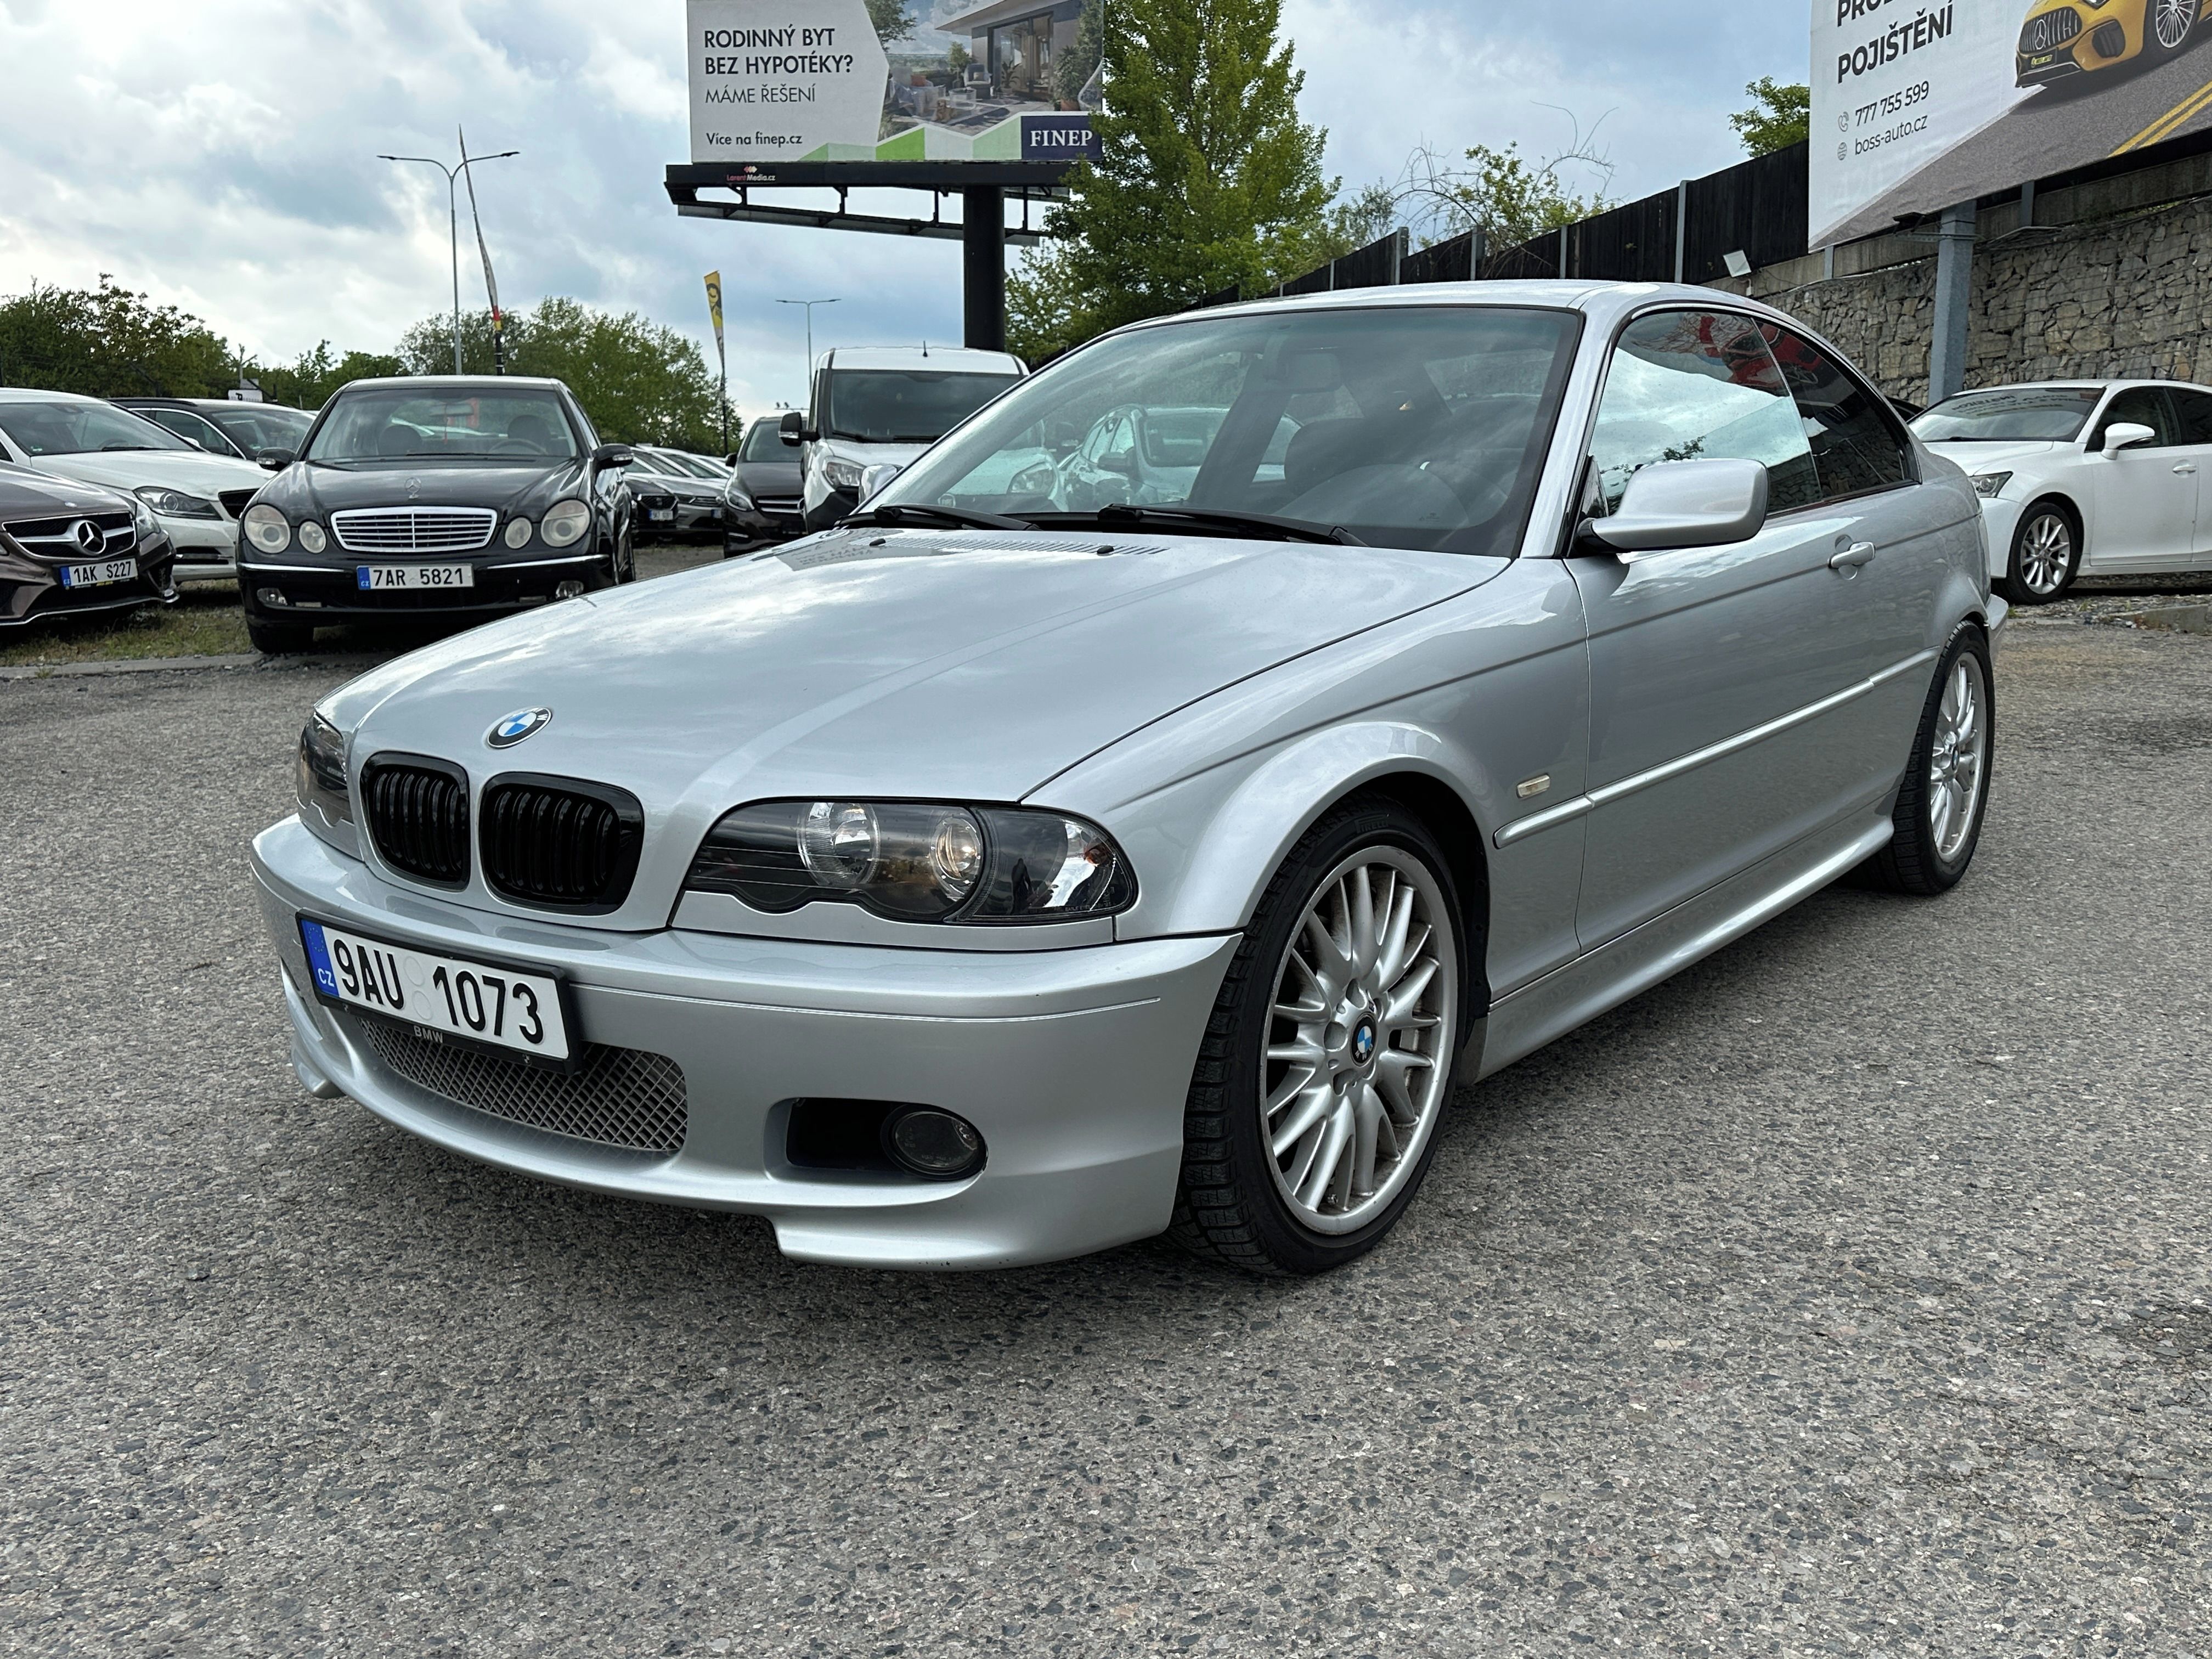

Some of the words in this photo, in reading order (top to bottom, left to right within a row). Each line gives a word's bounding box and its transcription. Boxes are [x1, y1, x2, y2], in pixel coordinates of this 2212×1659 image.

[704, 24, 796, 48] RODINNÝ
[803, 28, 835, 46] BYT
[1838, 0, 1953, 84] POJIŠTĚNÍ
[705, 57, 738, 75] BEZ
[746, 50, 854, 74] HYPOTÉKY?
[705, 84, 755, 103] MÁME
[761, 83, 816, 103] ŘEŠENÍ
[1855, 101, 1877, 127] 777
[1880, 91, 1902, 117] 755
[1904, 81, 1929, 106] 599
[706, 132, 732, 145] Více
[736, 137, 751, 145] na
[756, 131, 803, 148] finep.cz
[1030, 130, 1093, 146] FINEP
[1855, 115, 1928, 155] boss-auto.cz
[74, 566, 98, 583] 1AK
[106, 561, 131, 579] S227
[373, 569, 406, 586] 7AR
[420, 568, 464, 585] 5821
[318, 968, 335, 988] CZ
[333, 938, 405, 1011] 9AU
[432, 965, 544, 1045] 1073
[413, 1025, 443, 1043] BMW
